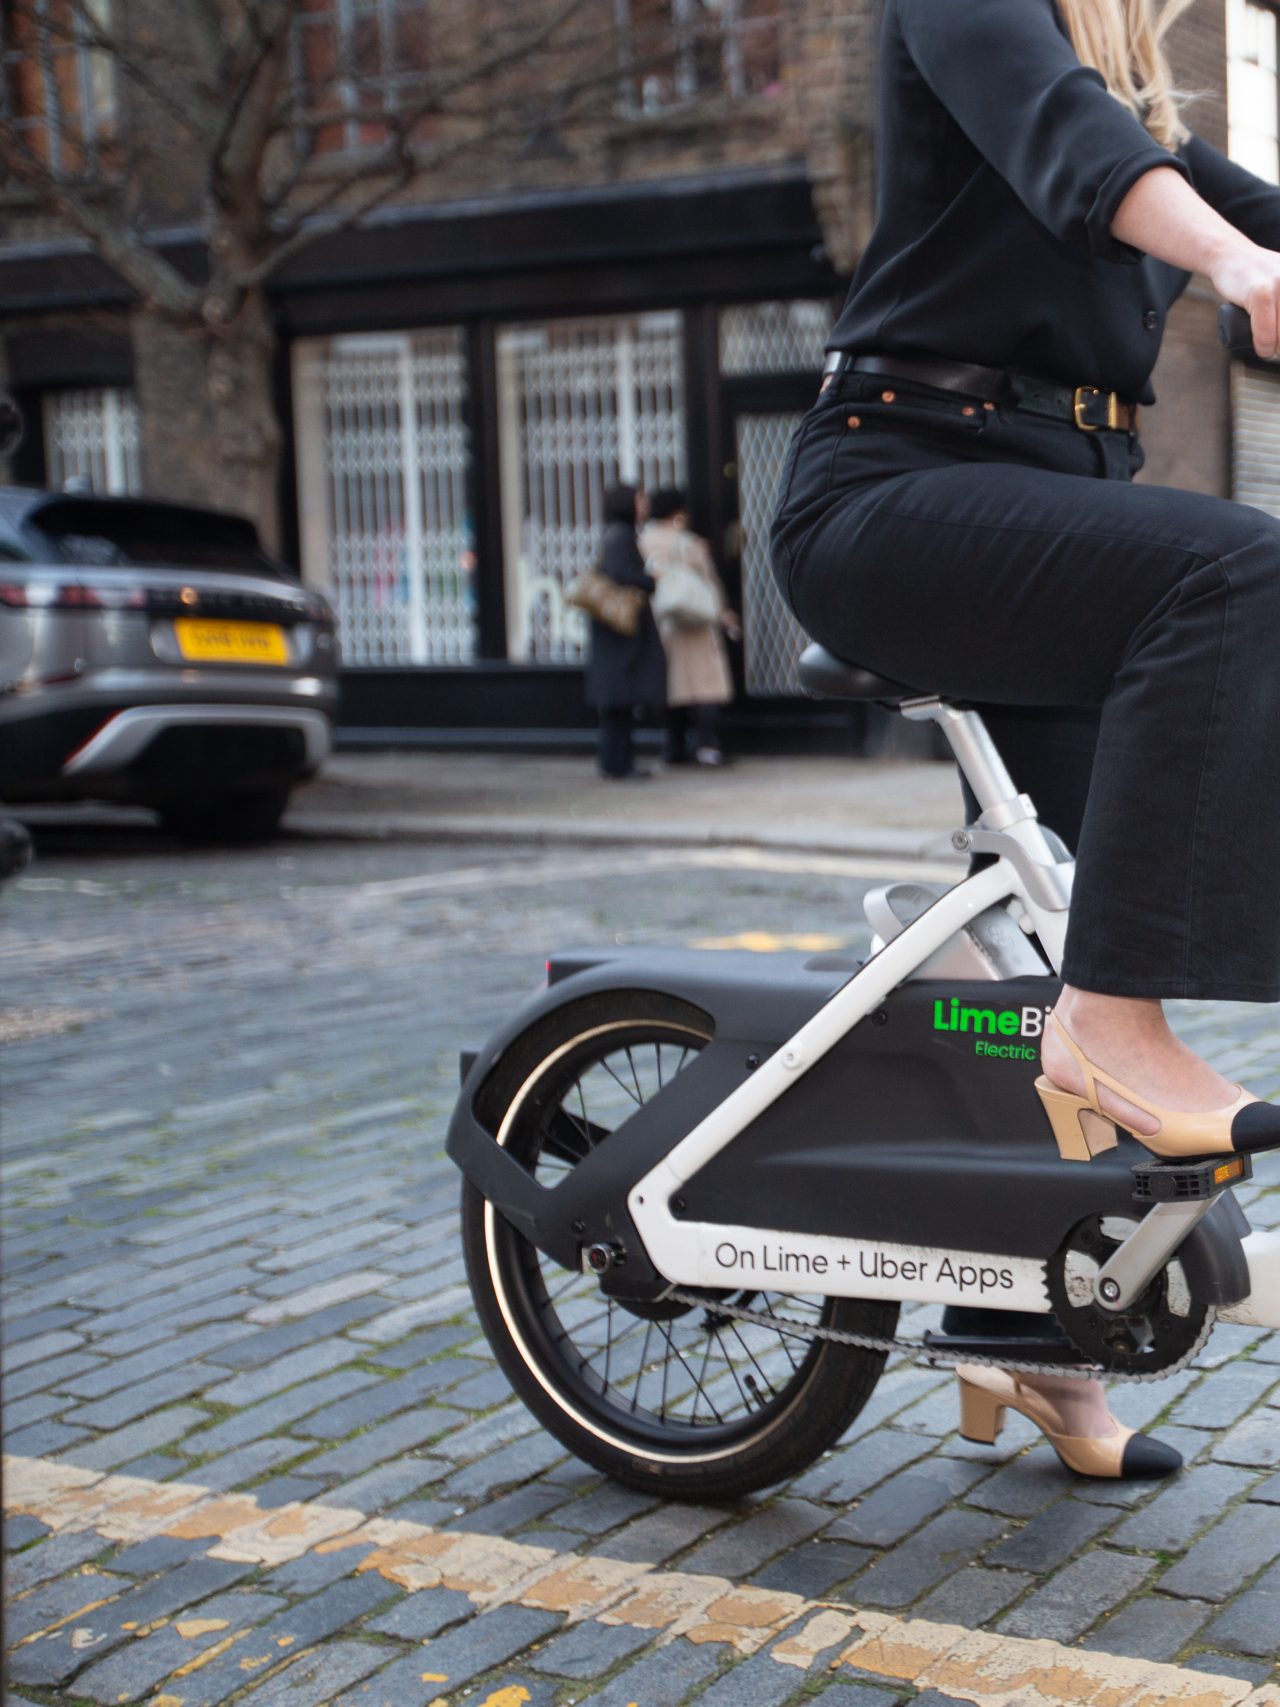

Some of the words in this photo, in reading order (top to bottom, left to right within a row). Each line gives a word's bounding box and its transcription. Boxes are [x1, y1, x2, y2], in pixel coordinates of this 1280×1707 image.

[975, 1041, 1036, 1061] Electric
[715, 1242, 755, 1269] On
[763, 1246, 829, 1274] Lime
[859, 1252, 928, 1281] Uber
[936, 1257, 1014, 1293] Apps
